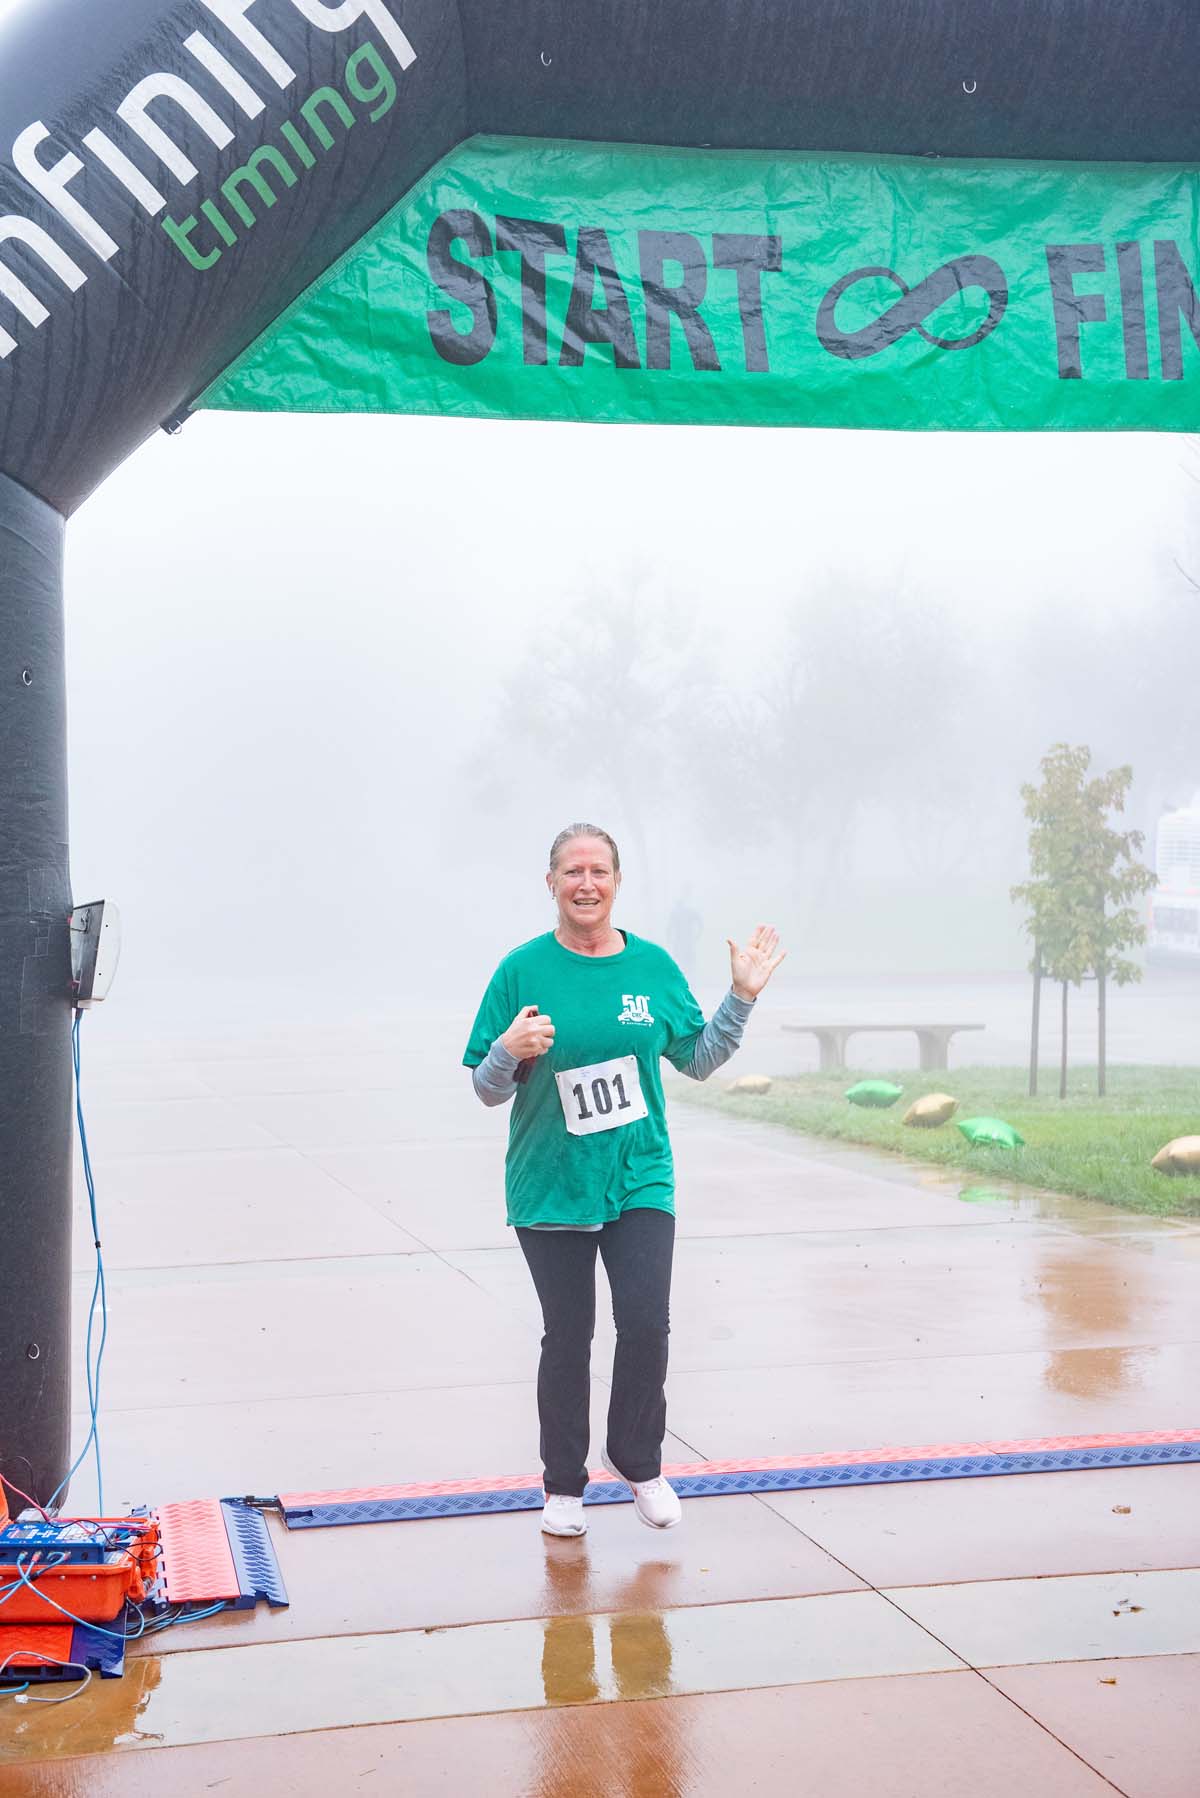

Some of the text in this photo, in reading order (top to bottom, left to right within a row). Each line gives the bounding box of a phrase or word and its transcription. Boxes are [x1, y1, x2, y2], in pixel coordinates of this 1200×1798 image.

[0, 0, 417, 359] nfinity
[161, 41, 397, 270] timing
[426, 209, 1200, 380] START FIN
[573, 1073, 631, 1120] 101
